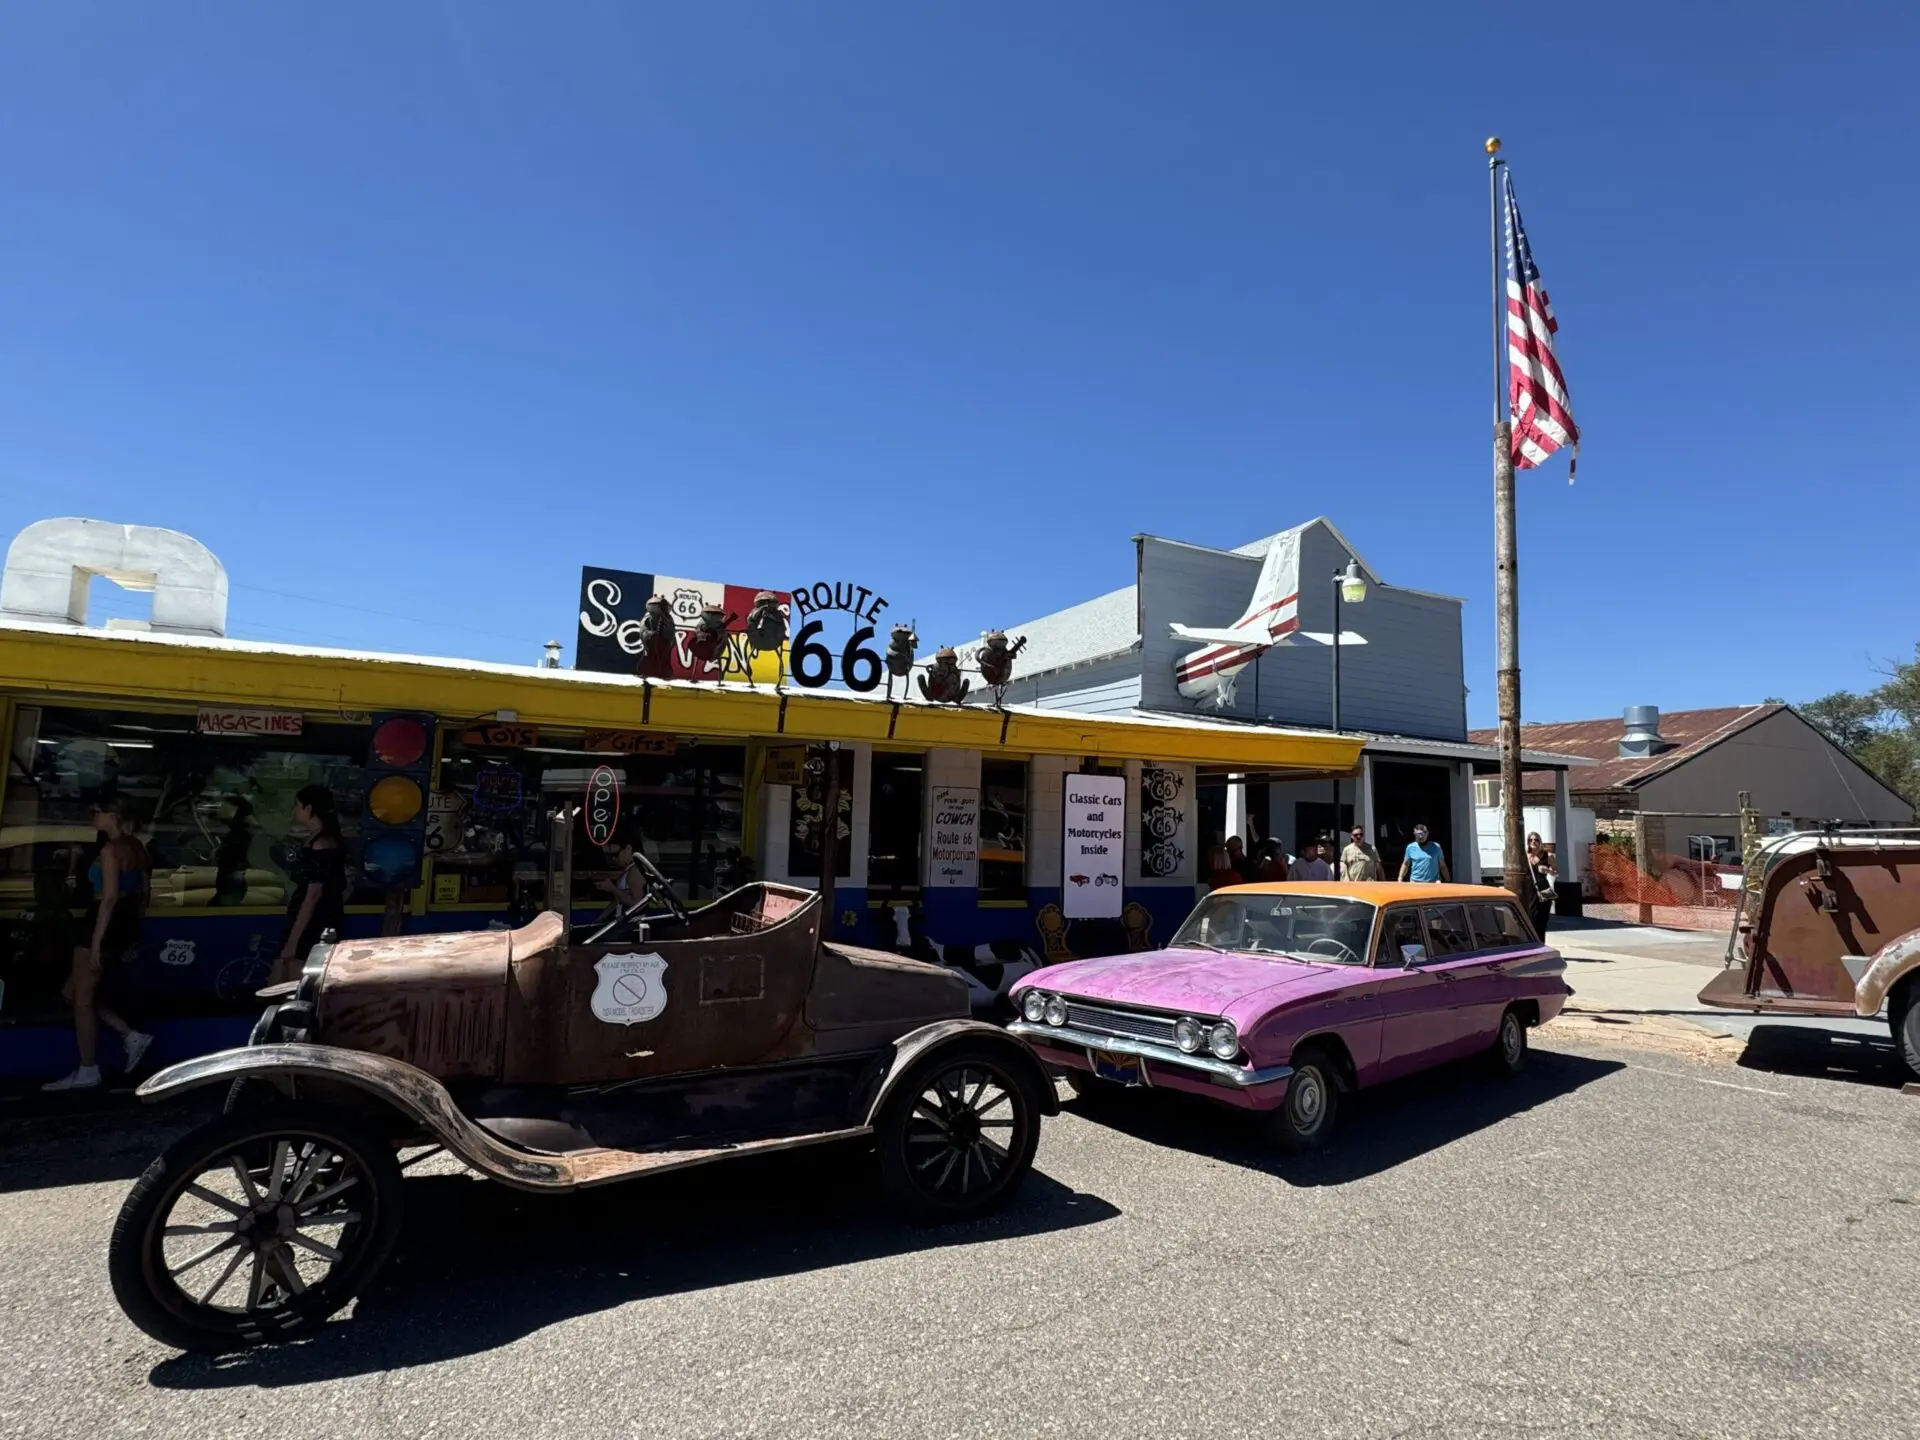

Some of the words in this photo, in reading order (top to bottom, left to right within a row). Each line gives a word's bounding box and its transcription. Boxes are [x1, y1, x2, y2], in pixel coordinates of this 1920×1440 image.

[678, 601, 697, 614] 66
[792, 581, 889, 625] ROUTE
[790, 620, 883, 692] 66
[198, 713, 302, 732] MAGAZINES
[1156, 783, 1172, 796] 66
[1069, 793, 1101, 805] Classic
[1102, 795, 1122, 806] Cars
[935, 812, 976, 825] COWCH
[1086, 811, 1104, 822] and
[1156, 820, 1172, 833] 66
[936, 831, 959, 845] Route
[962, 832, 973, 845] 66
[1067, 828, 1122, 841] Motorcycles
[1080, 844, 1108, 855] Inside
[1156, 856, 1172, 869] 66
[168, 950, 187, 962] 66
